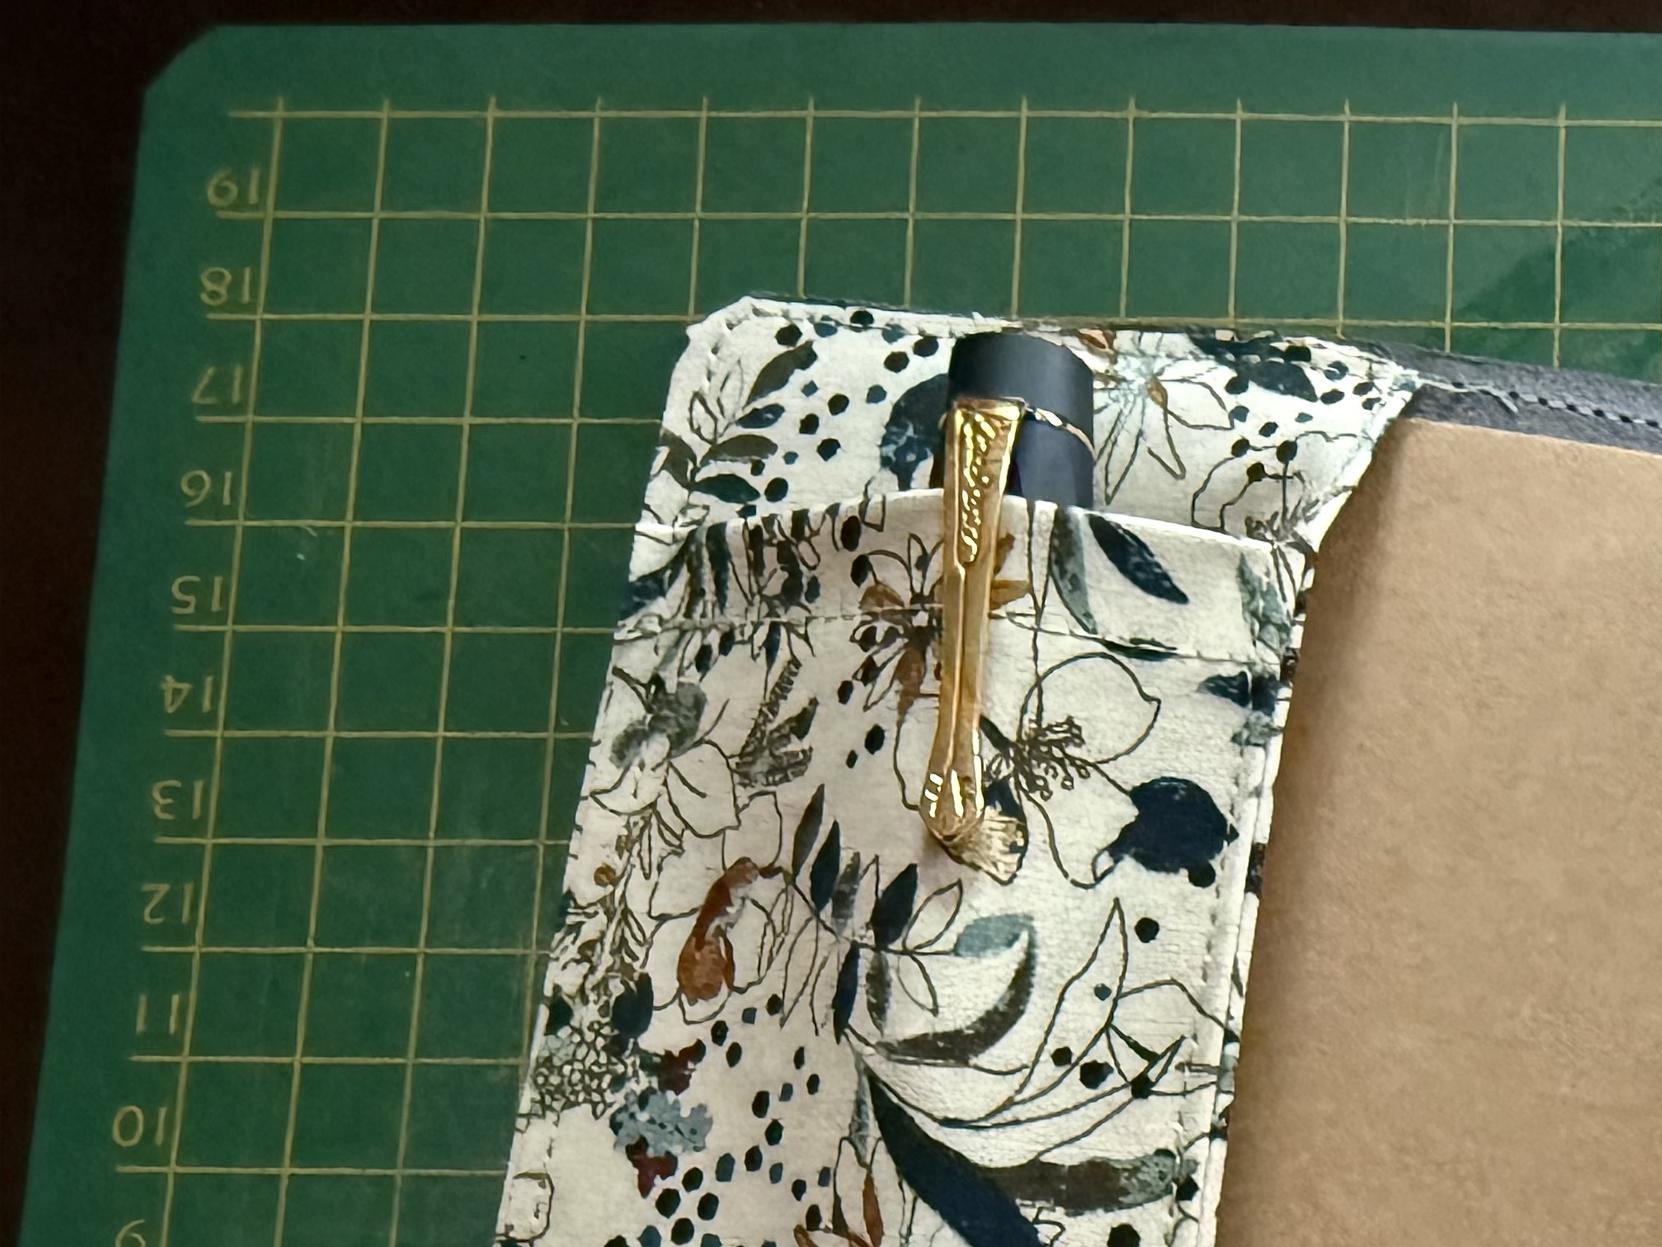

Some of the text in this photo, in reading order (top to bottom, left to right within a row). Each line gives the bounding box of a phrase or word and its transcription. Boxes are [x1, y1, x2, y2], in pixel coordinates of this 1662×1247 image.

[207, 167, 261, 206] 19
[200, 266, 251, 305] 18
[192, 364, 244, 404] 17
[180, 469, 232, 508] 16
[171, 575, 224, 614] 15
[161, 674, 213, 713] 14
[151, 779, 204, 820] 13
[141, 881, 194, 924] 12
[136, 993, 179, 1035] 11
[112, 1105, 167, 1147] 10
